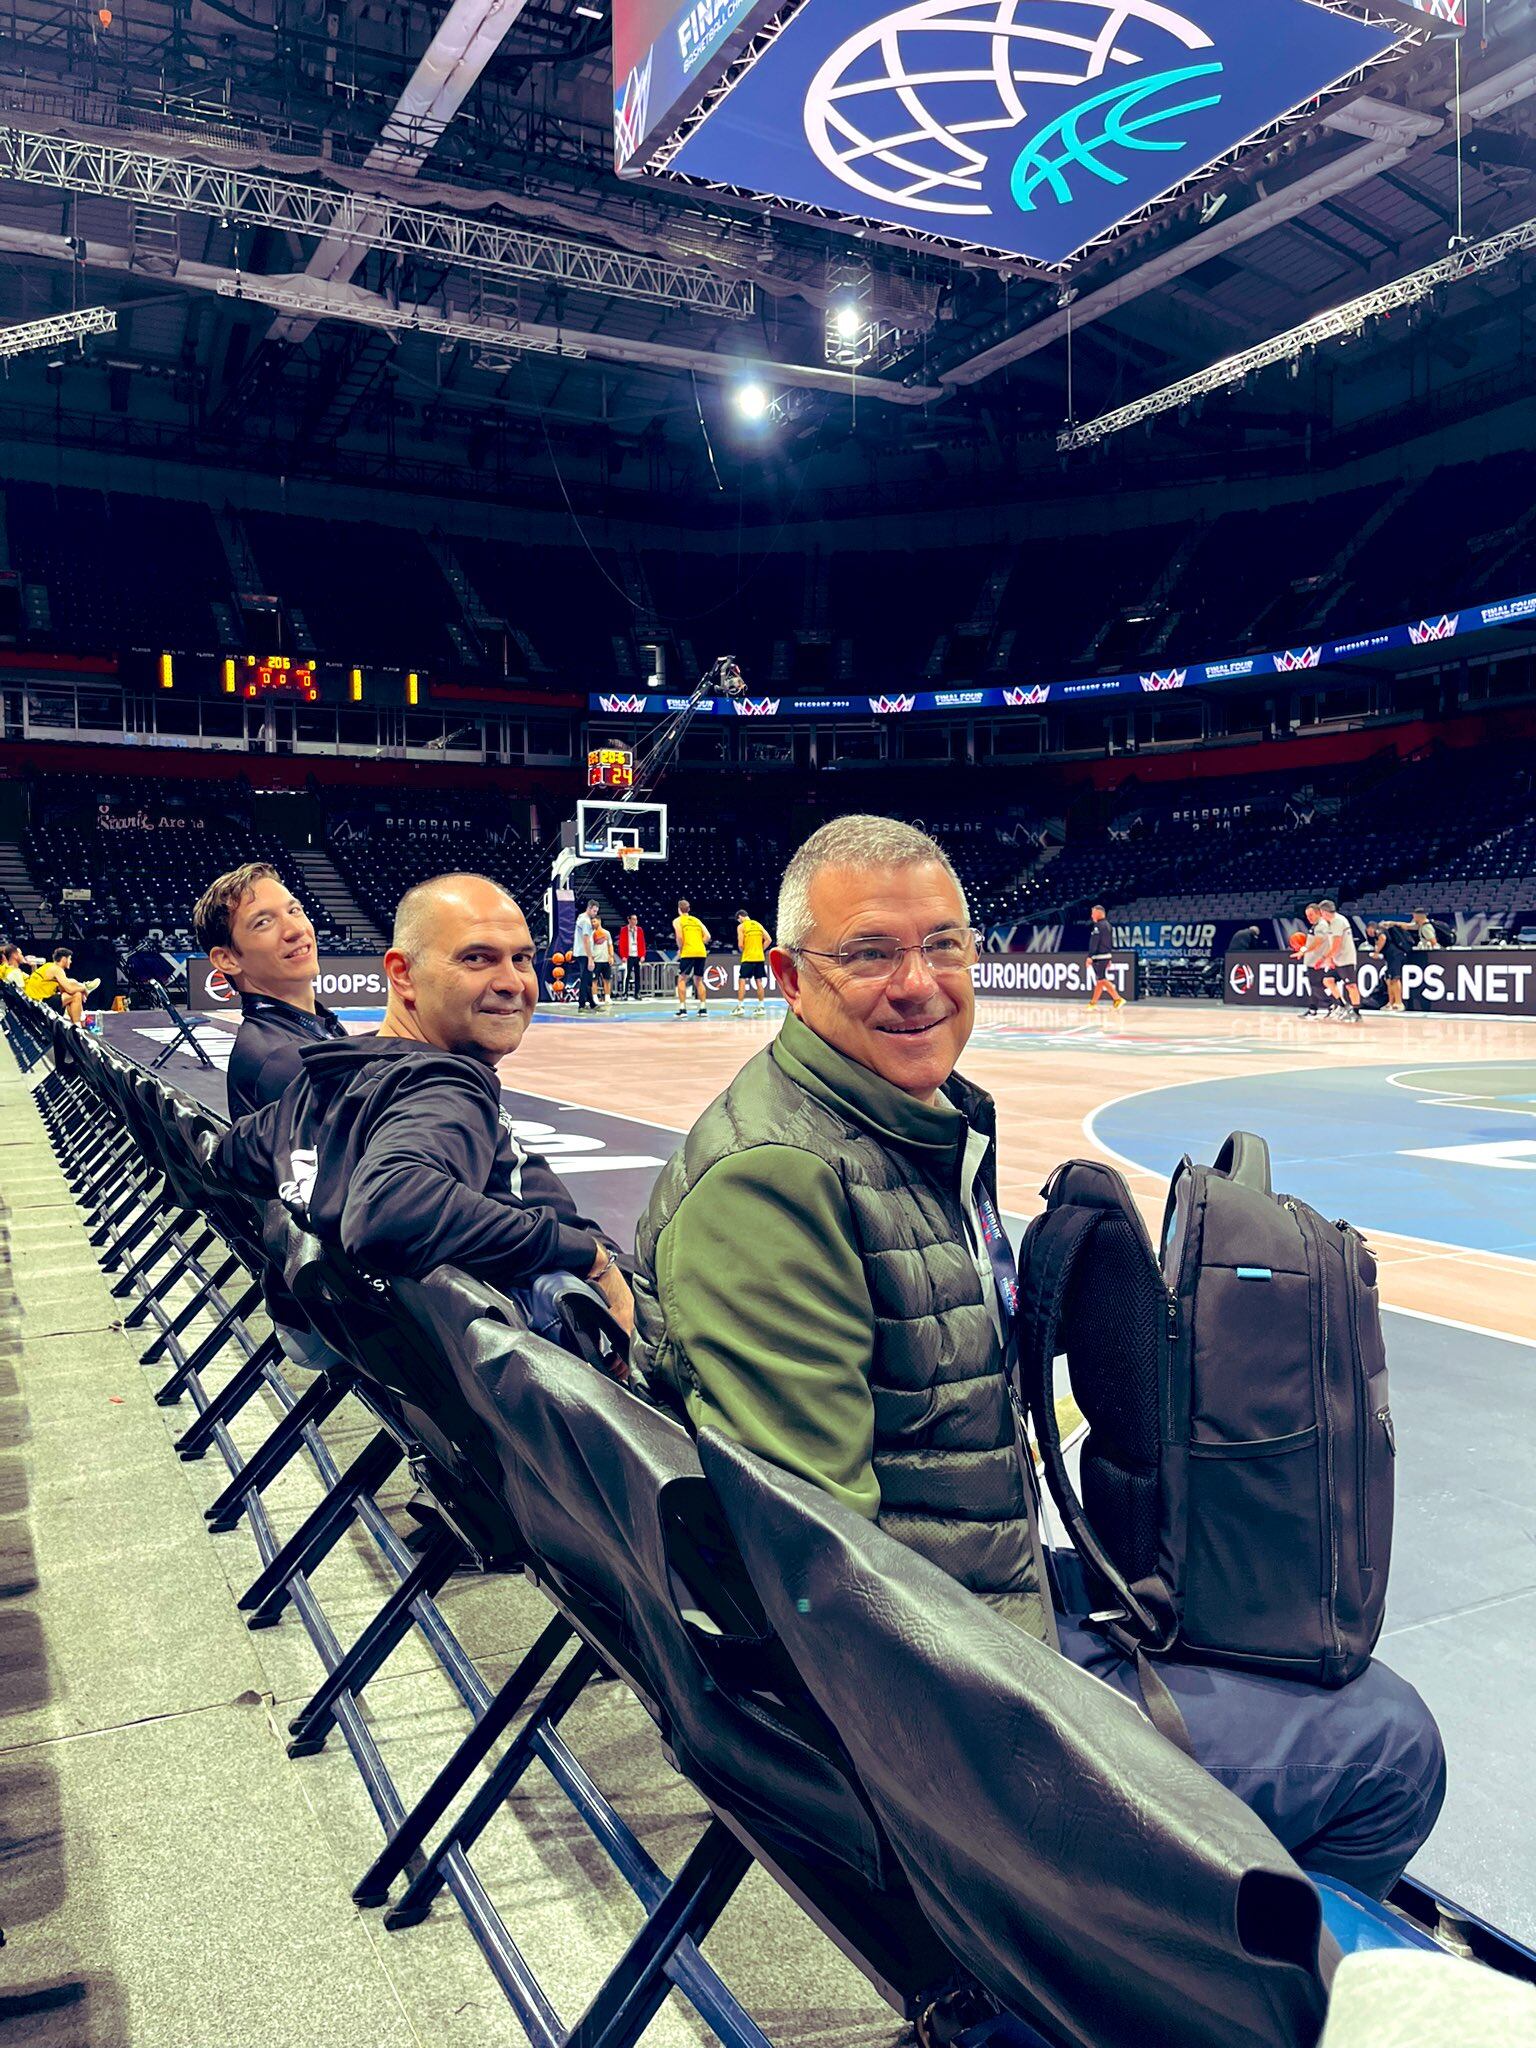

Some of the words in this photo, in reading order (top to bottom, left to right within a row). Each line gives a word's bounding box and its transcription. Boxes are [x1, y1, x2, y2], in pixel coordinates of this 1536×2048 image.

[612, 767, 632, 785] 24
[158, 816, 204, 828] Area
[1111, 926, 1156, 948] INAL
[1159, 924, 1216, 948] FOUR
